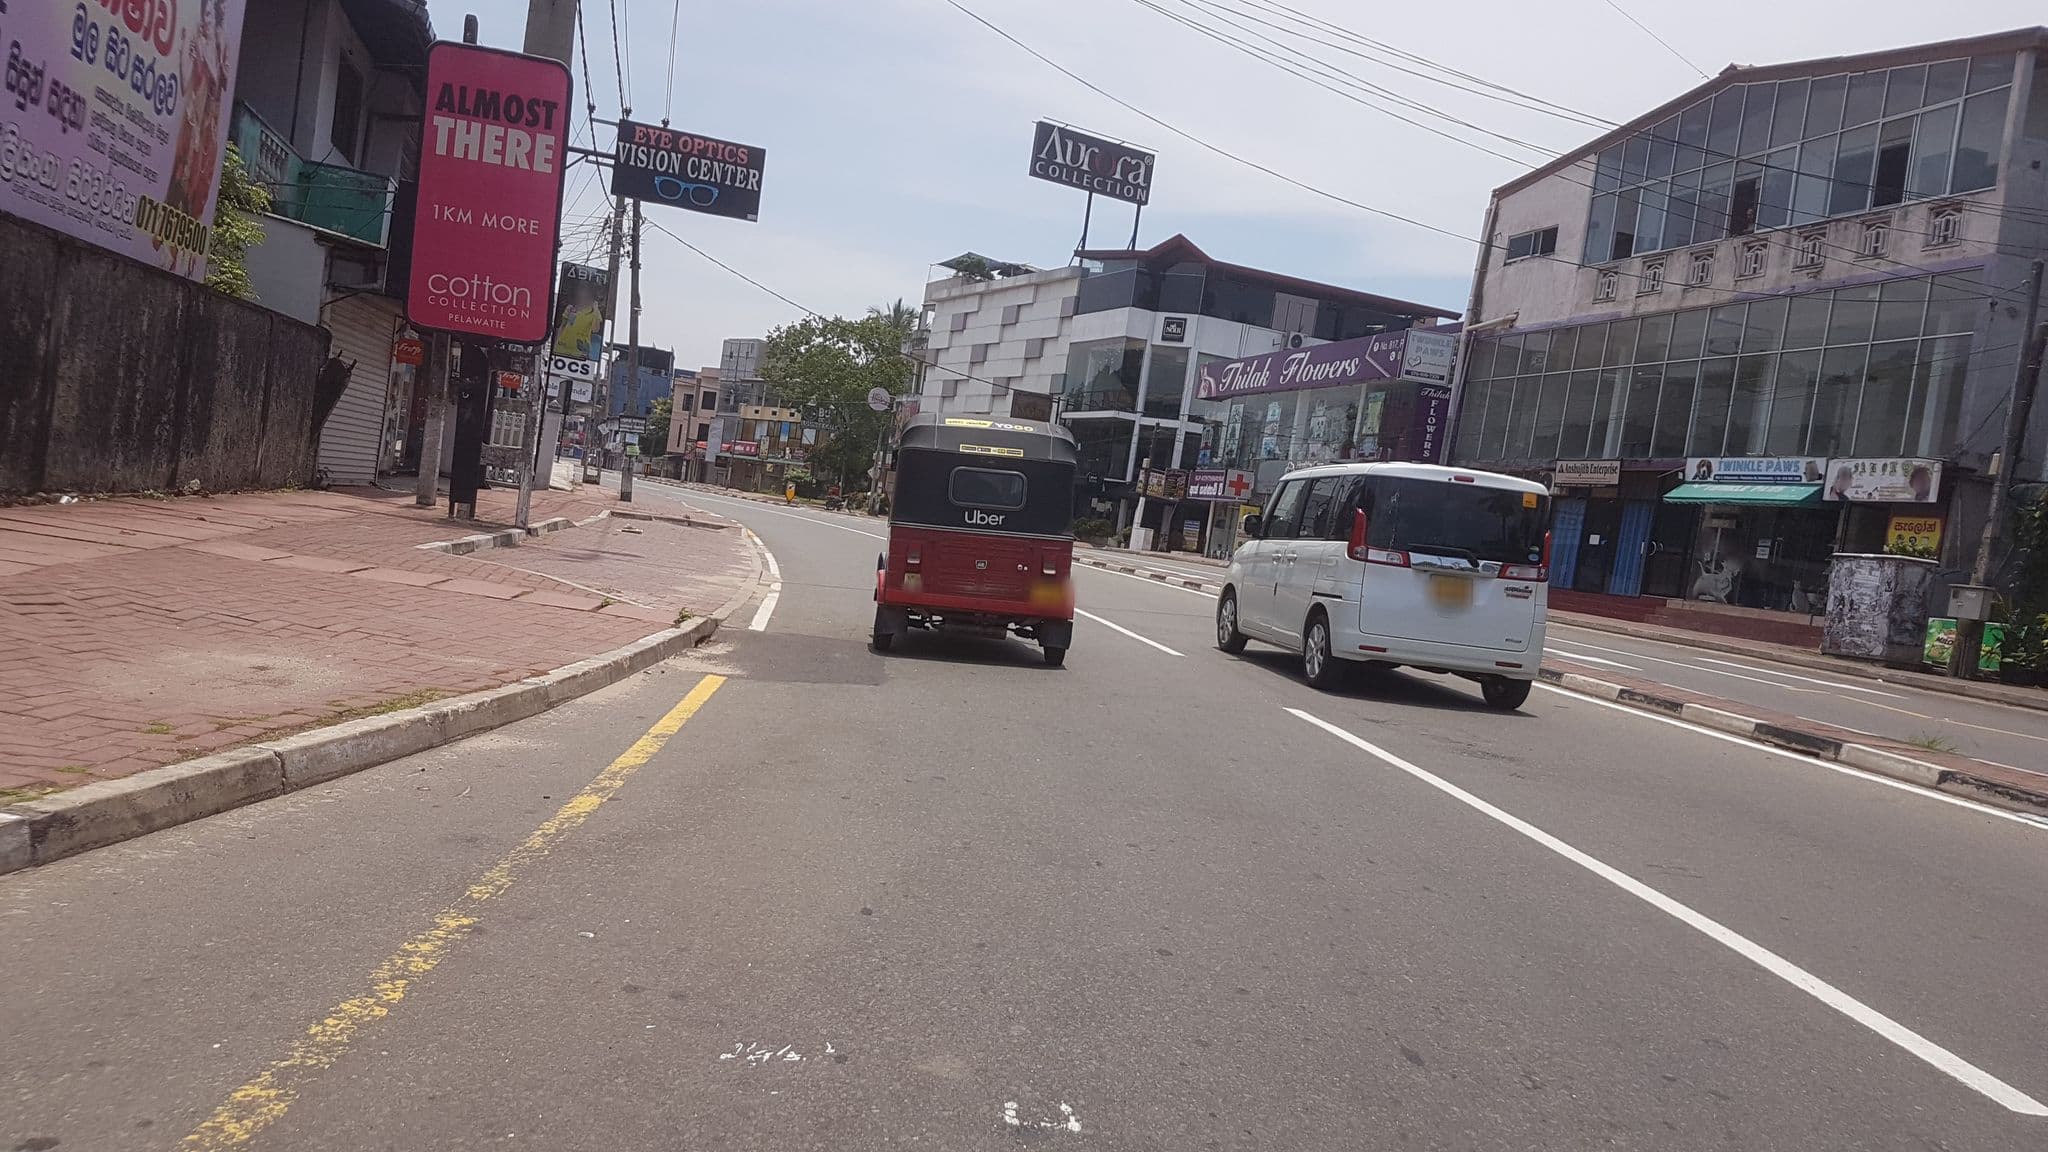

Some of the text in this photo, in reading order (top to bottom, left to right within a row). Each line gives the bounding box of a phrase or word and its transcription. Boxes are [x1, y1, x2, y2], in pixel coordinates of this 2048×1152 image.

[435, 82, 559, 130] ALMOST
[433, 115, 556, 174] THERE
[634, 125, 749, 165] EYE OPTICS
[618, 141, 760, 191] VISION CENTER
[1035, 161, 1148, 203] COLLECTION
[135, 193, 208, 256] 0717679500
[433, 204, 540, 235] 1KM MORE
[428, 274, 531, 308] cotton
[428, 295, 531, 319] COLLECTION
[448, 312, 507, 330] PELAWATTE
[1219, 351, 1361, 392] Thilak Flowers
[1420, 386, 1451, 400] Thilak
[1422, 399, 1439, 458] FLOWERS
[1590, 463, 1619, 477] Enterprise
[1718, 460, 1800, 473] TWINKLE PAWS
[964, 509, 1006, 526] Uber
